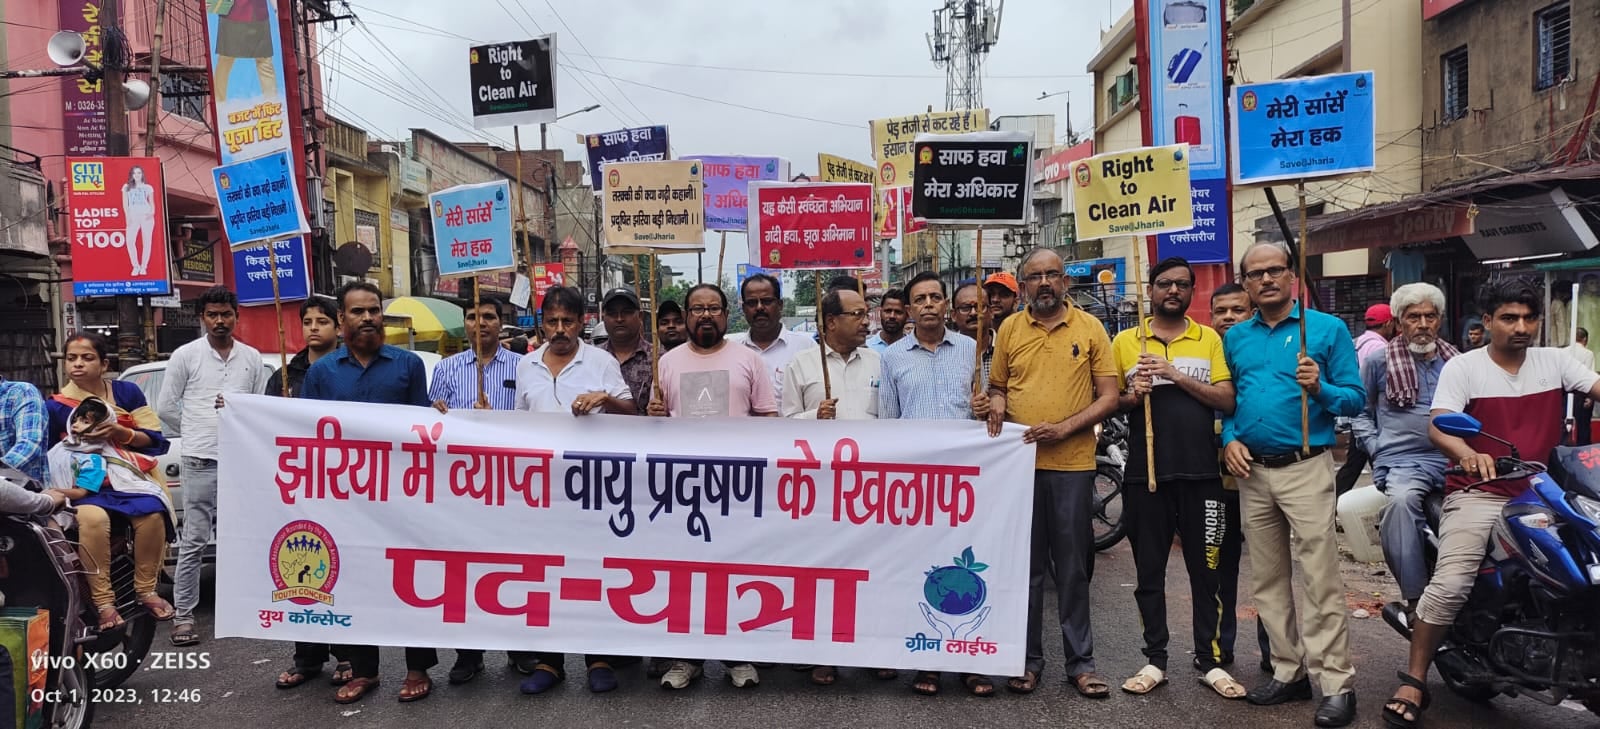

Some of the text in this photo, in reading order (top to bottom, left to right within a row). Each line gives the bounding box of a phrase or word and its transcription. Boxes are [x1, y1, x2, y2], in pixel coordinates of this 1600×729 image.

[488, 45, 523, 66] Right
[500, 67, 512, 80] to
[478, 81, 538, 102] Clean Air
[228, 102, 282, 124] बजट में फिट
[1266, 90, 1349, 119] मेरी सांसें
[901, 114, 920, 135] तेजी
[922, 113, 930, 132] से
[933, 117, 948, 131] कट
[949, 113, 961, 132] रहे
[962, 110, 972, 130] हैं
[224, 118, 283, 153] पूजा हिट
[602, 128, 652, 146] साफ हवा
[1270, 126, 1343, 148] मेरा हक
[883, 138, 907, 158] इंसान
[938, 149, 1008, 167] साफ हवा
[73, 163, 102, 175] CITI
[735, 165, 761, 180] हवा
[1102, 154, 1154, 180] Right
[634, 185, 643, 200] की
[645, 189, 657, 201] क्या
[924, 176, 1019, 198] मेरा अधिकार
[1119, 181, 1138, 196] to
[74, 208, 119, 218] LADIES
[445, 200, 493, 227] मेरी सांसें
[762, 201, 775, 216] यह
[777, 195, 796, 214] कैसी
[830, 194, 863, 214] अभियान
[1088, 194, 1177, 221] Clean Air
[74, 219, 101, 228] TOP
[610, 210, 631, 232] प्रदूषित
[632, 209, 651, 227] झरिया
[666, 209, 689, 226] निशानी
[1480, 221, 1547, 238] RAVI GARMENTS
[75, 232, 126, 249] ₹100
[764, 225, 782, 244] गंदी
[803, 228, 820, 249] झूठा
[821, 223, 856, 241] अभिमान
[1169, 230, 1216, 245] एक्सेसरीज
[450, 238, 493, 257] मेरा हक
[183, 259, 213, 273] RESIDENCY
[275, 415, 981, 543] झरिया में व्याप्त वायु प्रदूषण के खिलाफ
[1205, 499, 1218, 544] BRONX
[273, 588, 333, 603] YOUTH CONCEPT
[385, 547, 870, 643] पद-यात्रा
[258, 608, 352, 628] युथ कॉन्सेप्ट
[905, 632, 998, 656] ग्रीन लाईफ
